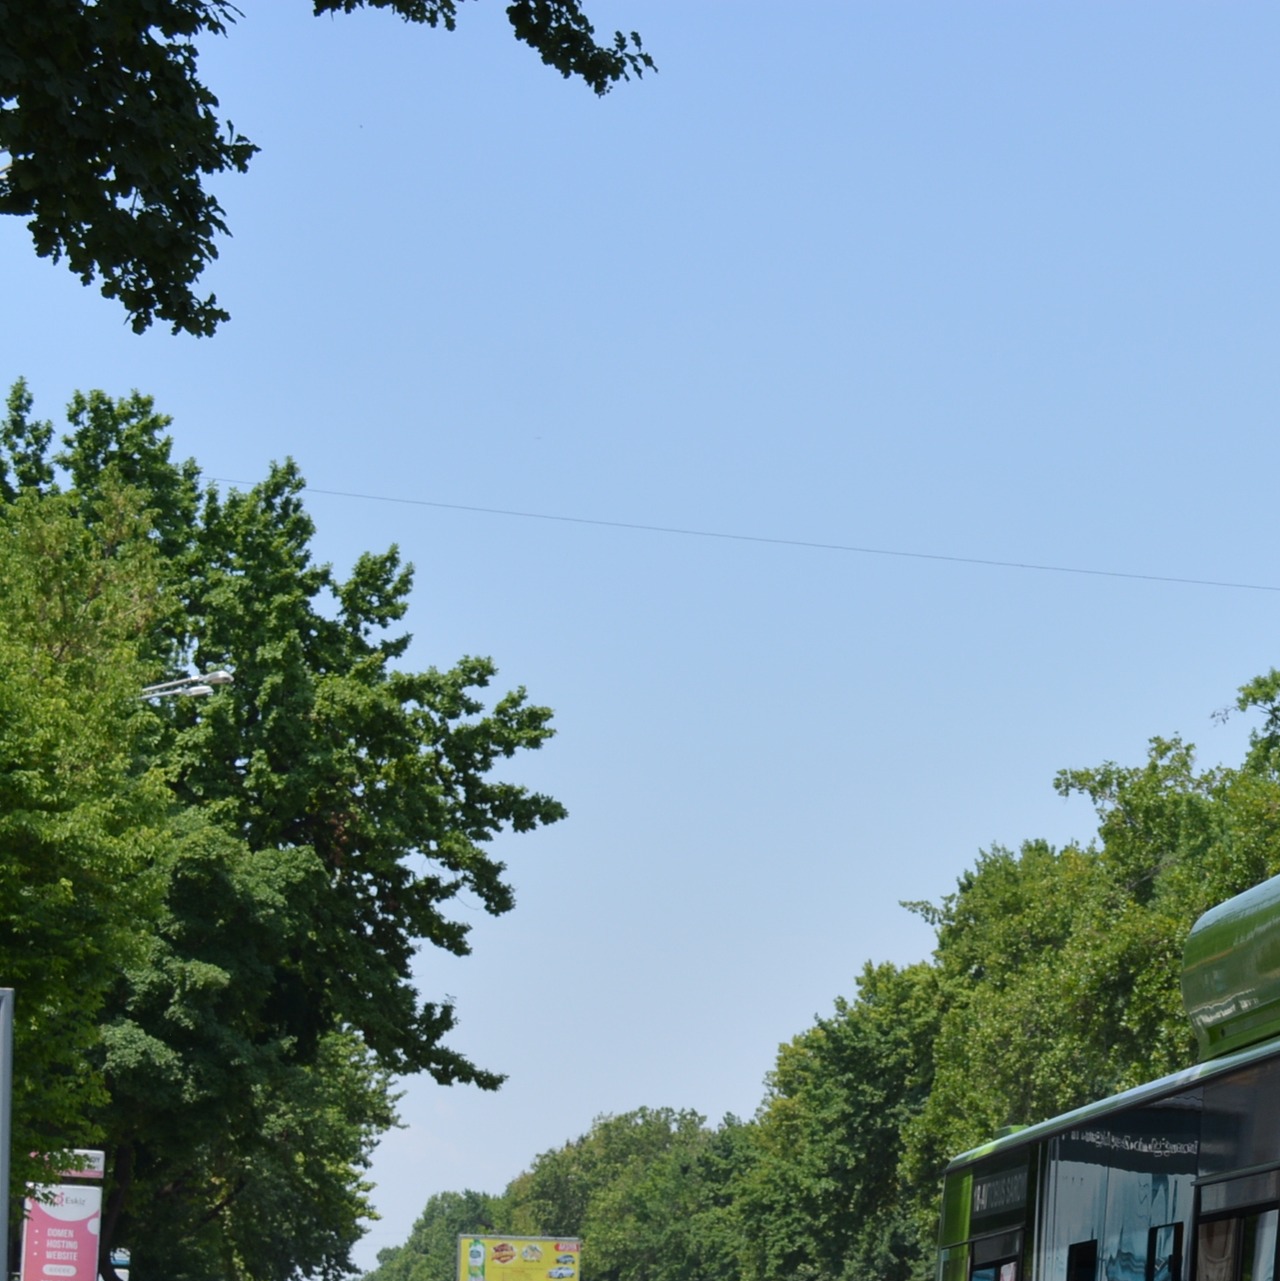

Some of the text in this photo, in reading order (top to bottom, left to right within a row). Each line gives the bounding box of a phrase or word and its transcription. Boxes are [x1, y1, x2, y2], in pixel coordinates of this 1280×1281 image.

[47, 1228, 74, 1238] DOMEN
[46, 1239, 78, 1250] HOSTING
[46, 1250, 78, 1261] WEBSITE
